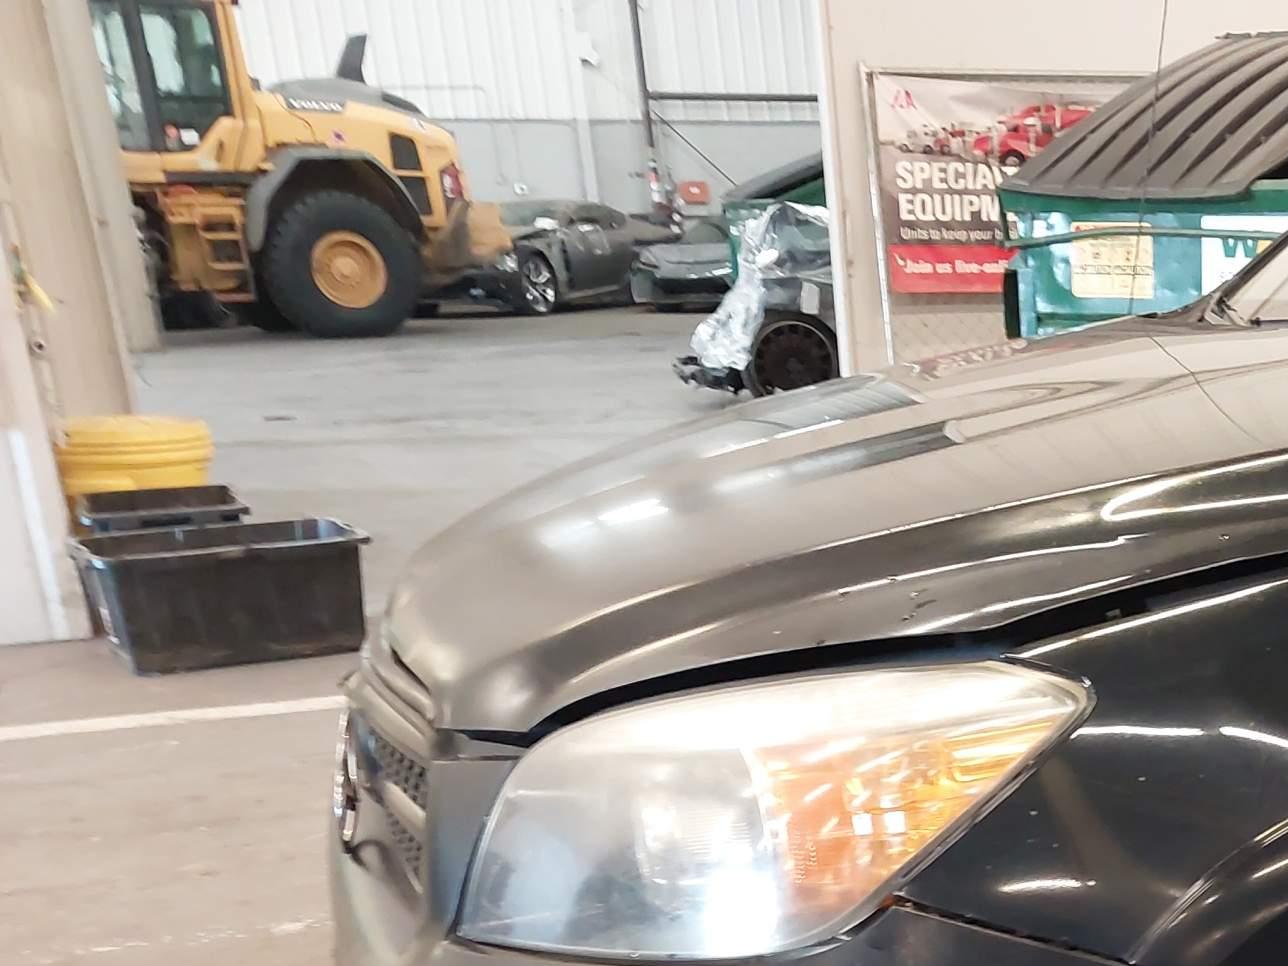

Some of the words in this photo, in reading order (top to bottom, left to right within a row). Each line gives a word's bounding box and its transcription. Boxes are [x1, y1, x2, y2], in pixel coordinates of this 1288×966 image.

[968, 229, 993, 242] your
[903, 259, 934, 274] Join
[935, 262, 953, 274] us
